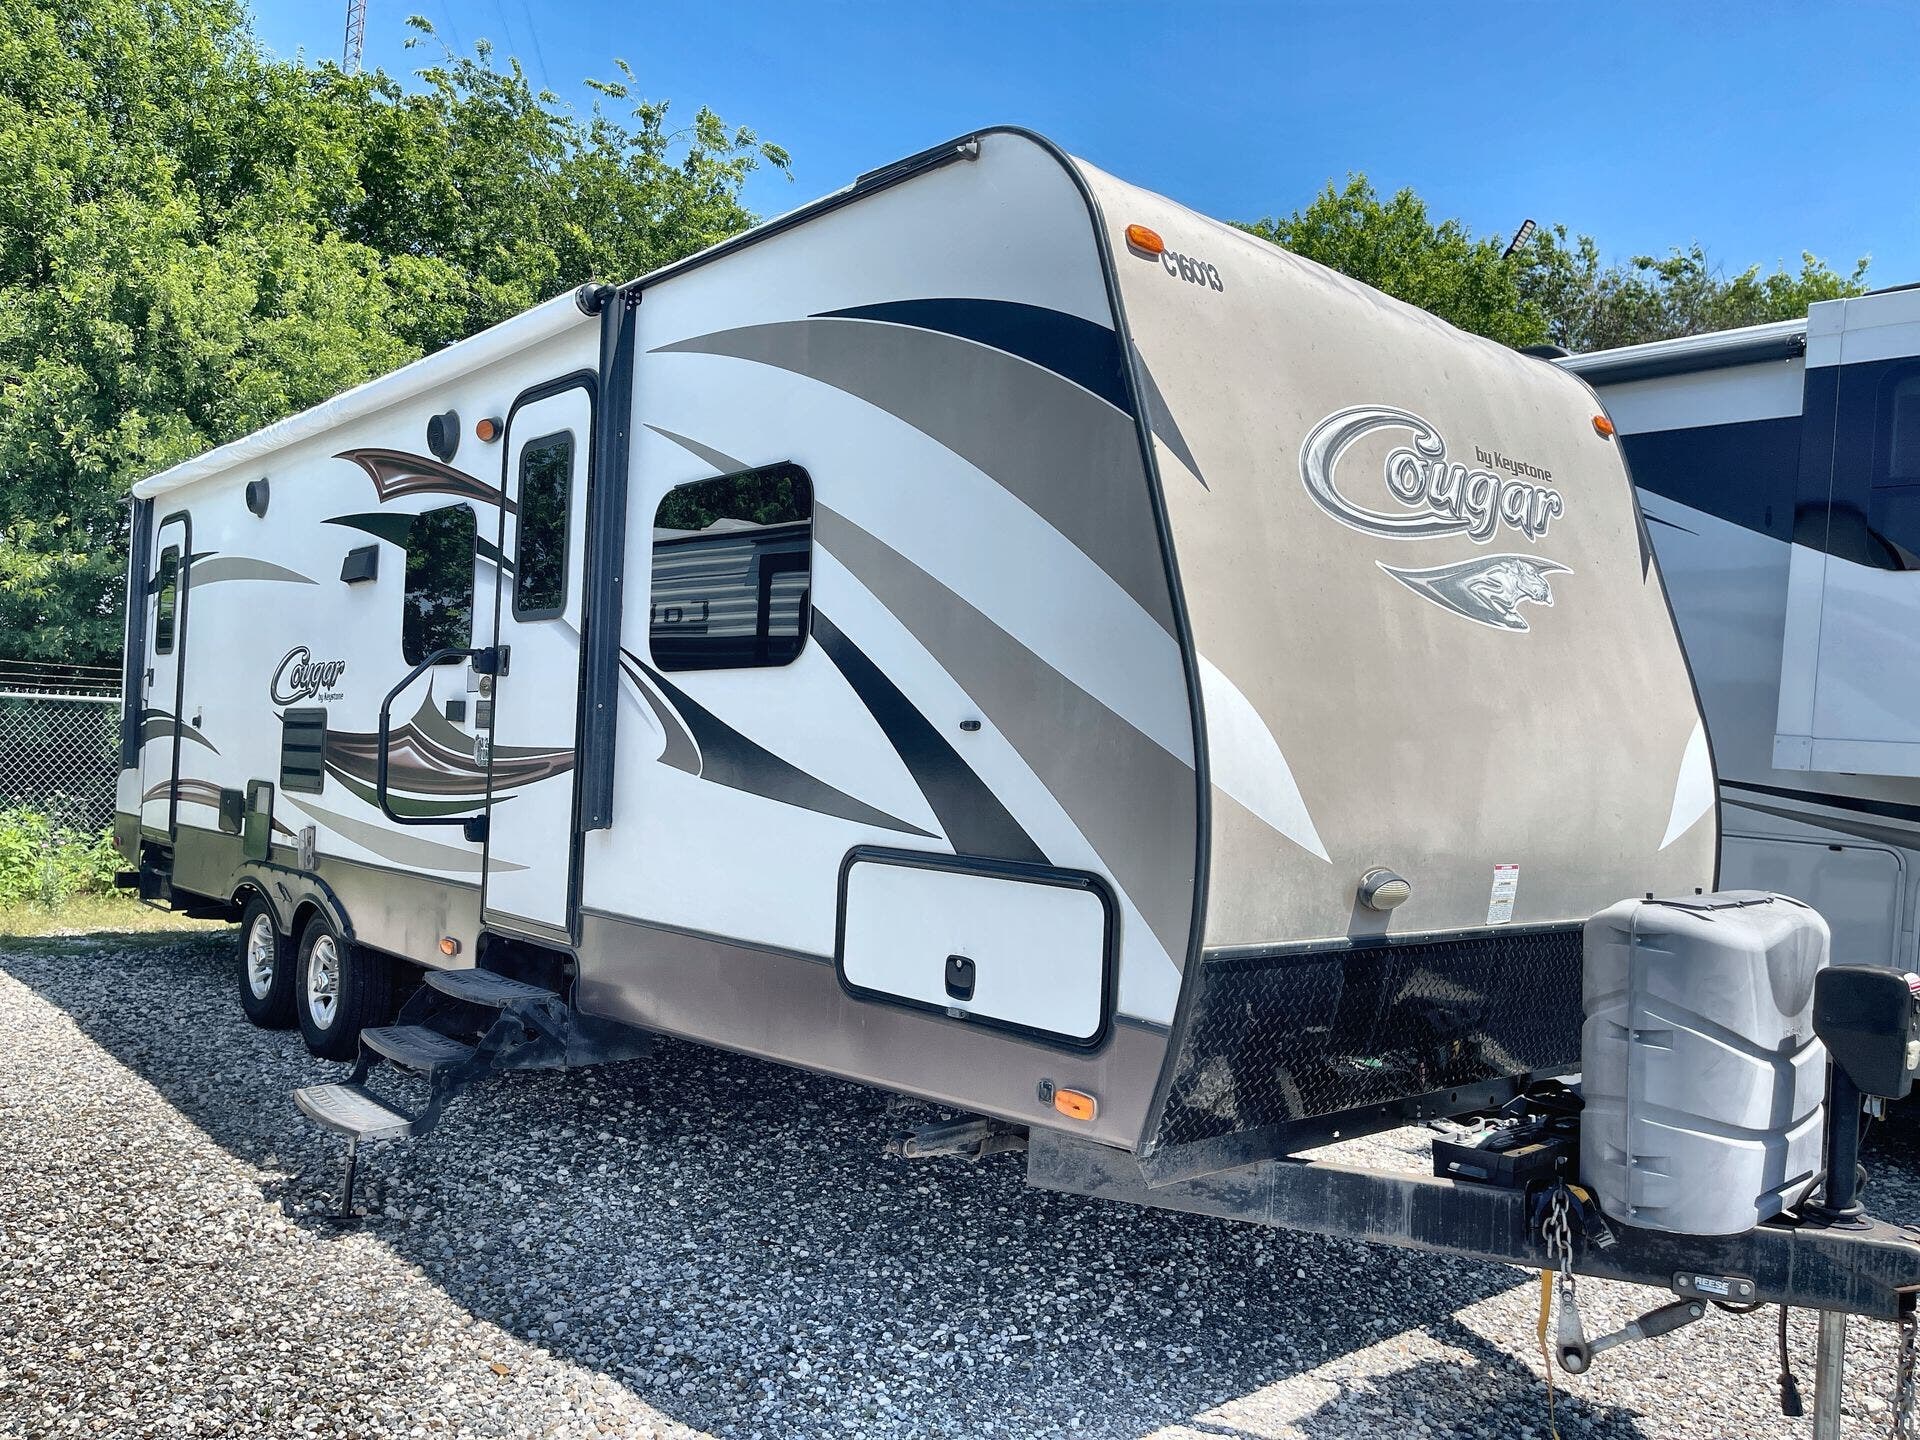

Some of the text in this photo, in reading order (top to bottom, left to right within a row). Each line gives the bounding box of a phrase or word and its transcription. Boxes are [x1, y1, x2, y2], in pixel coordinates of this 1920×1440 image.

[1161, 248, 1224, 293] C16013
[1300, 404, 1564, 544] Cougar
[1475, 445, 1552, 482] by Keystone
[271, 645, 346, 706] Cougar
[1694, 1276, 1729, 1291] REESE
